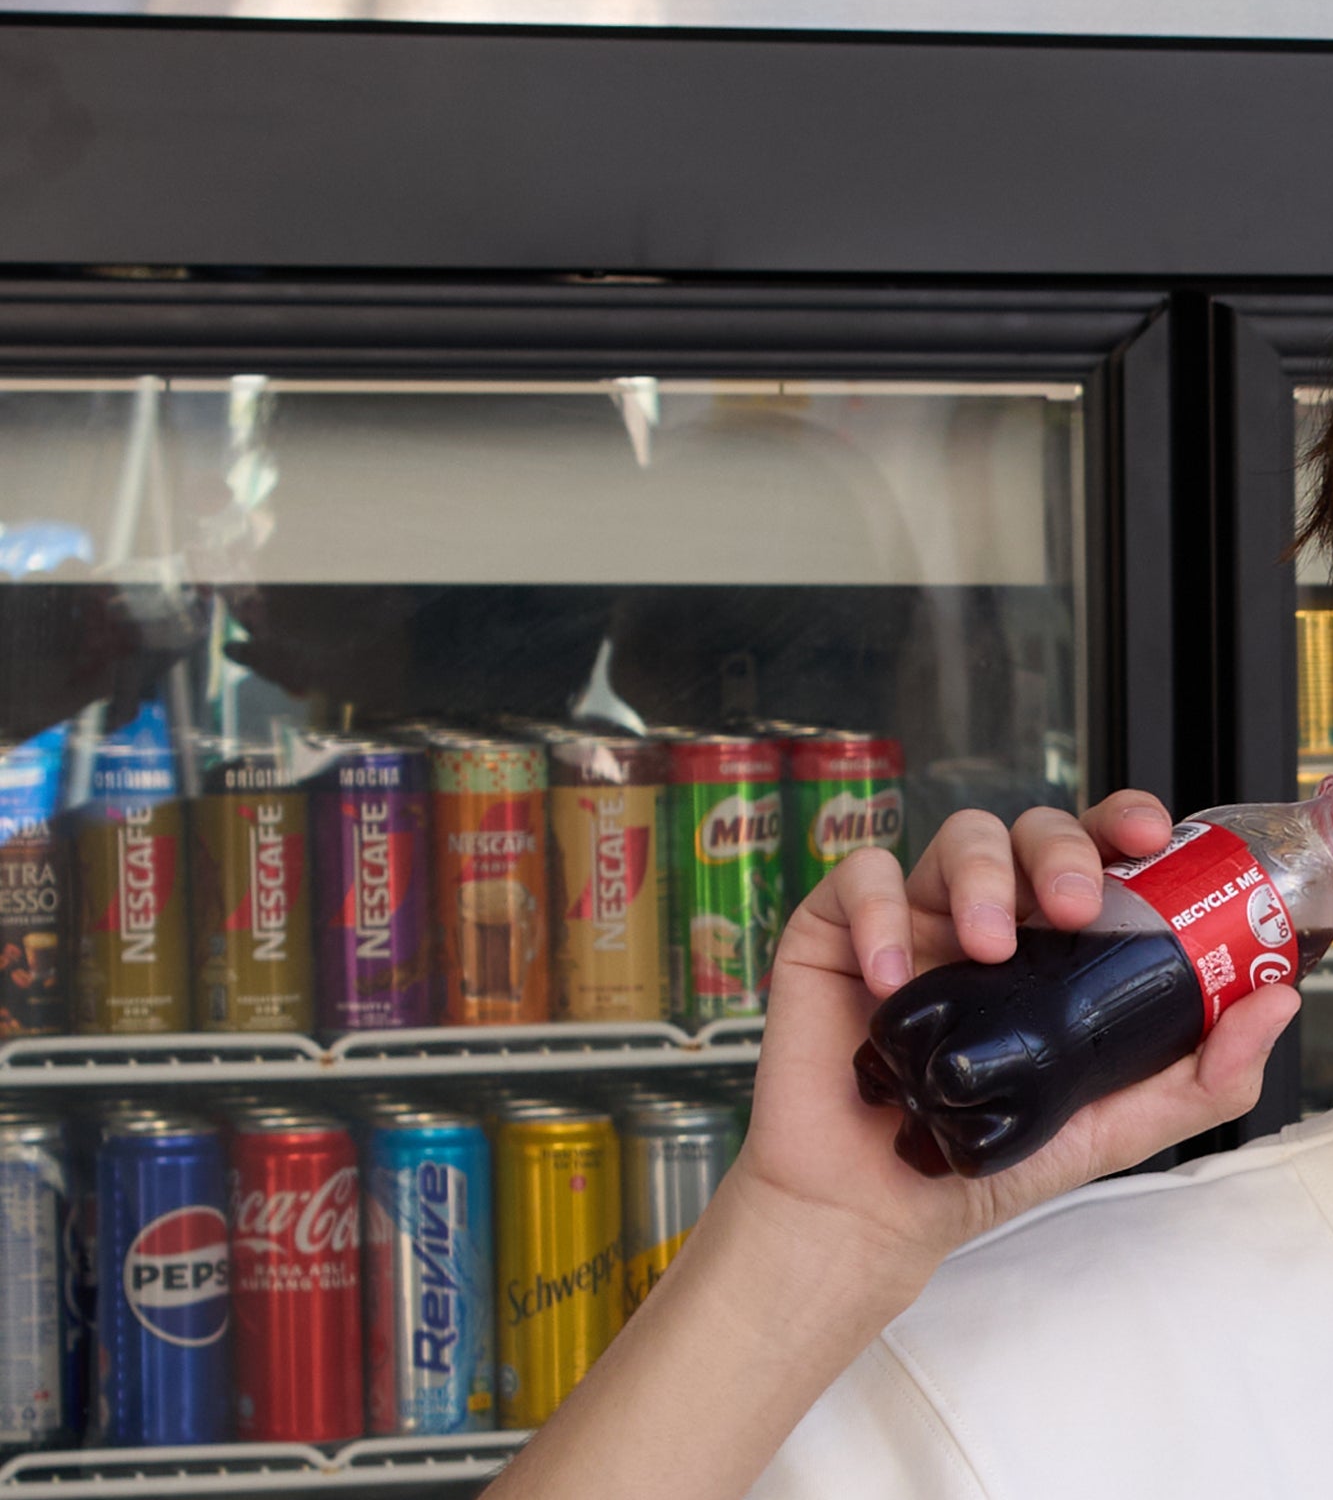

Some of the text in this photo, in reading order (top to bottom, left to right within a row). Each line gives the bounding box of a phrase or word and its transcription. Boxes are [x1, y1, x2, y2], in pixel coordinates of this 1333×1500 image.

[339, 768, 400, 788] MOCHA
[821, 808, 900, 844] MILO
[0, 862, 57, 887] TRA
[0, 887, 59, 914] ESSO
[1170, 882, 1239, 931] RECYCLE
[1236, 867, 1264, 891] ME
[132, 1260, 229, 1291] PEPS
